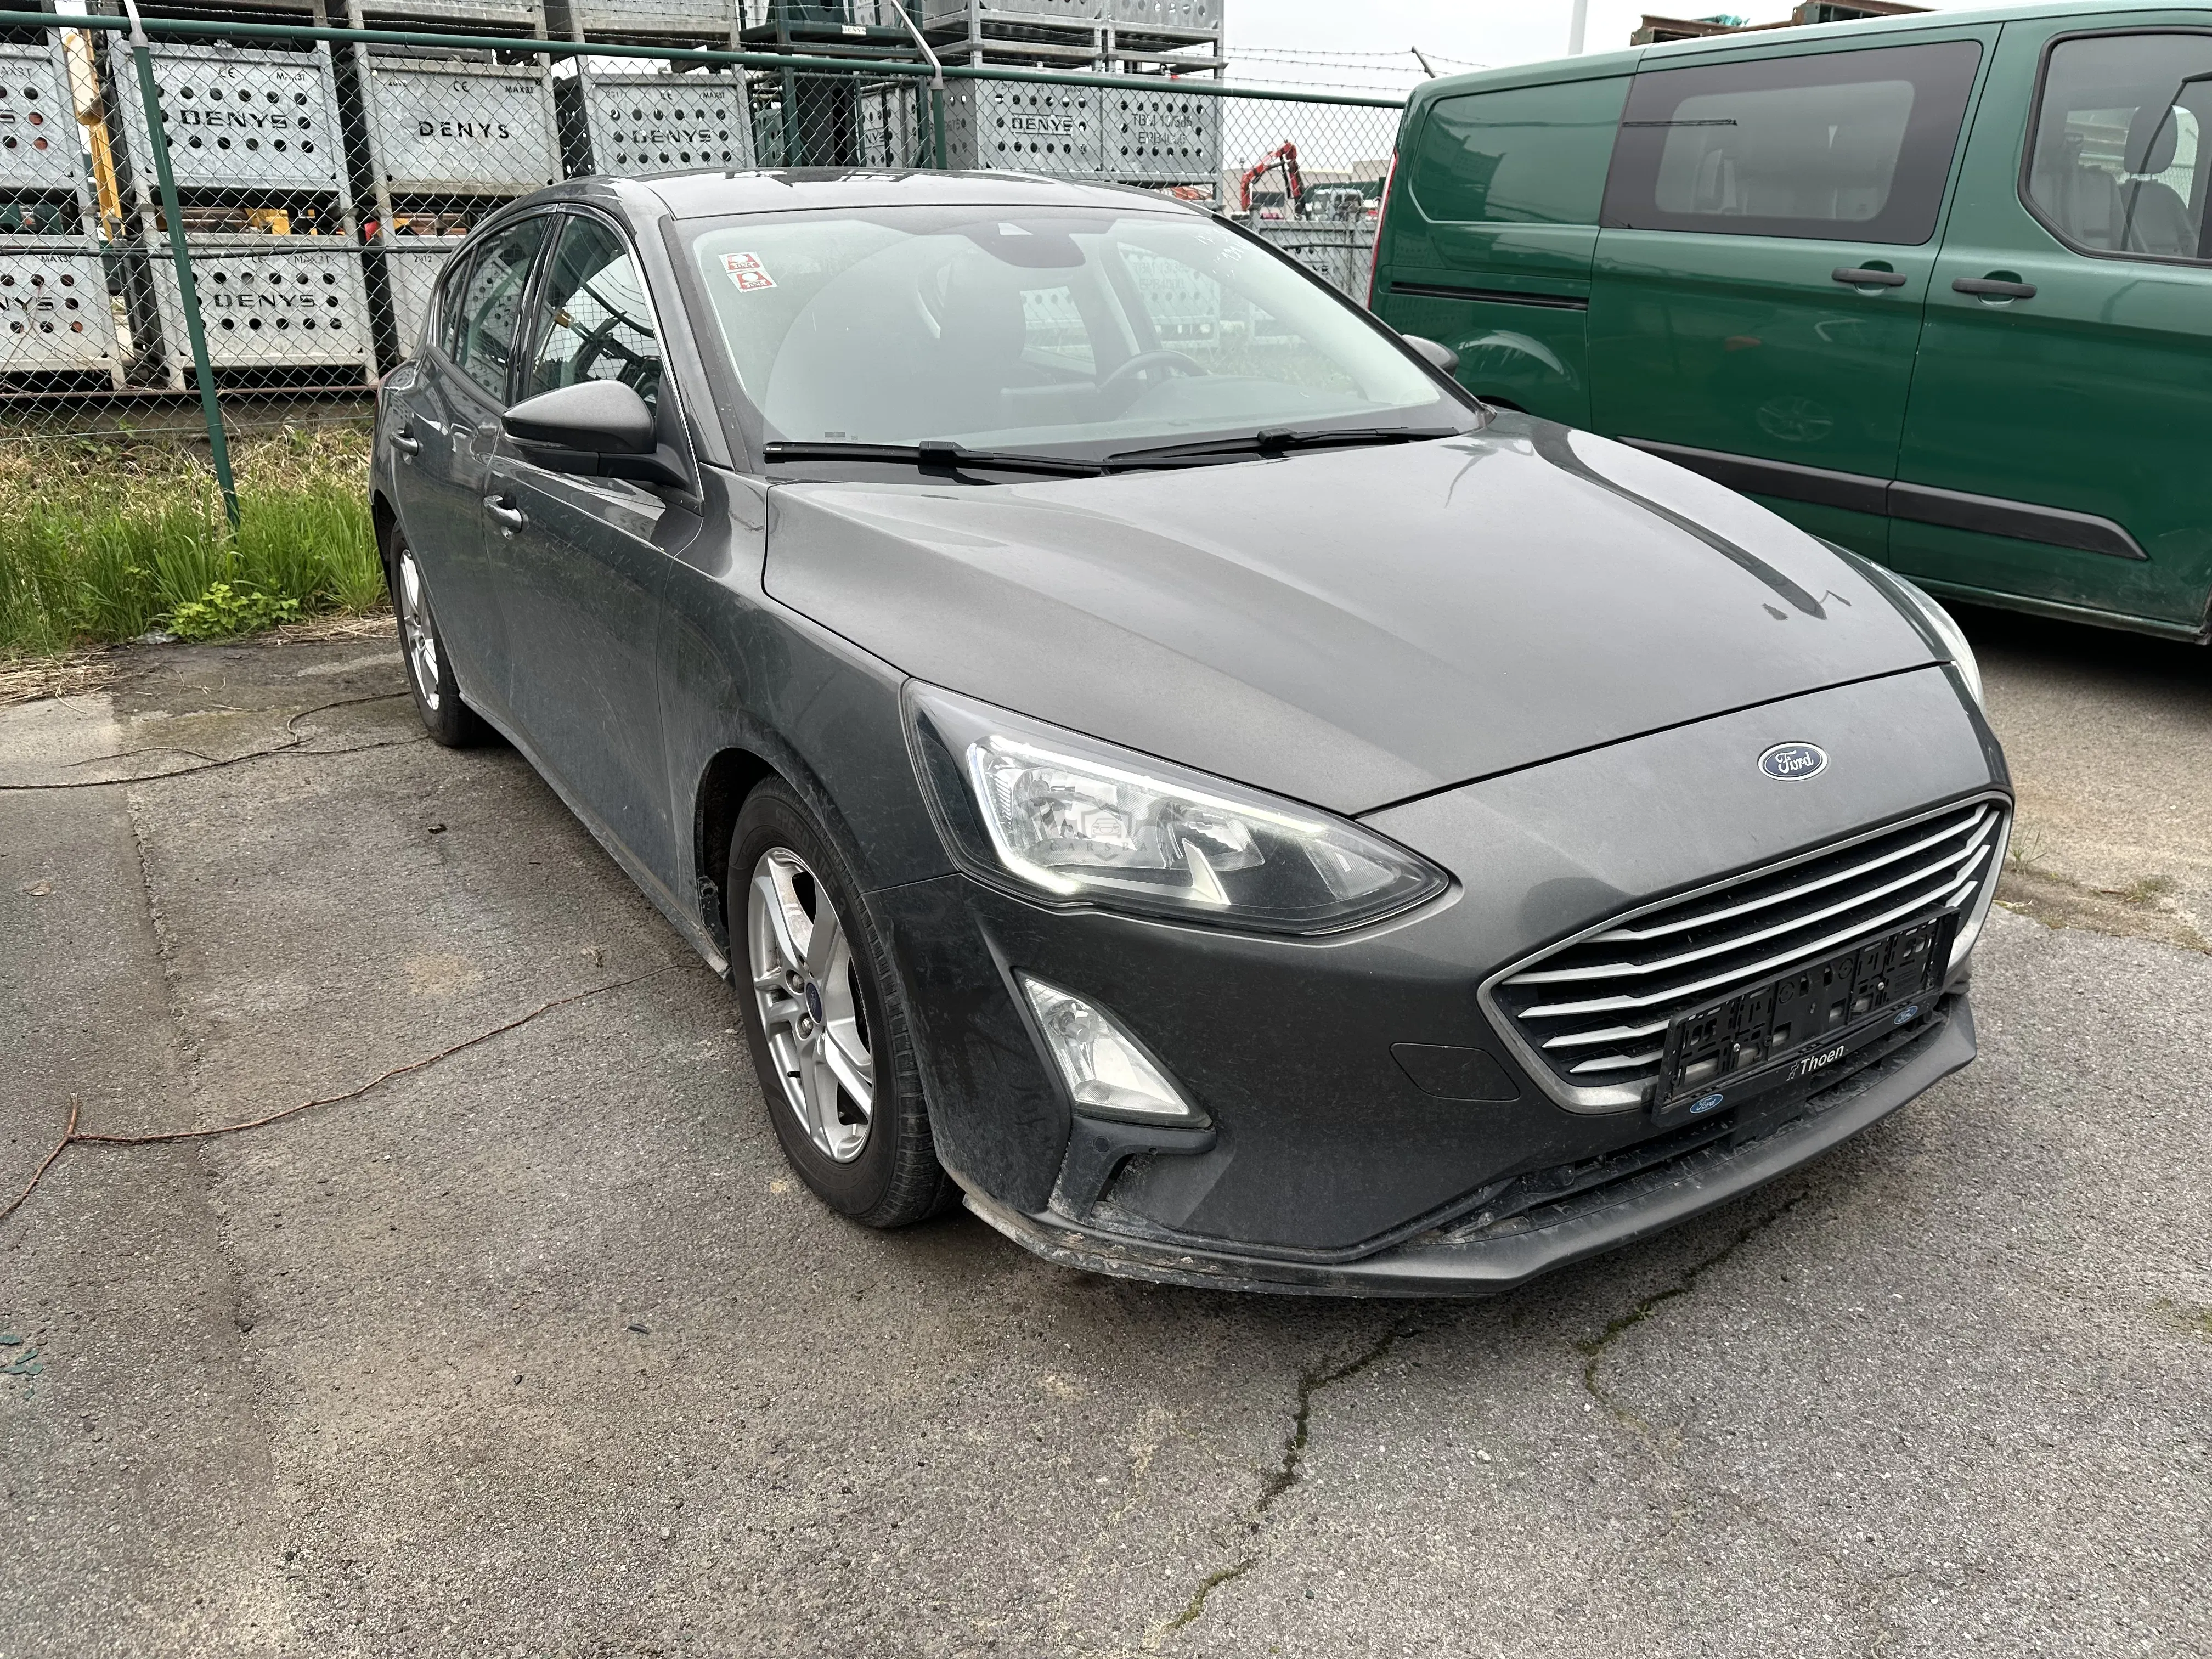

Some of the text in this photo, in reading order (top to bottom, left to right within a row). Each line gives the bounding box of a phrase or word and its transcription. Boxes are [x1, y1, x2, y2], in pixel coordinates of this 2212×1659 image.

[1, 66, 32, 77] AX3T
[151, 64, 168, 72] 017
[505, 85, 534, 94] MAX3T
[703, 91, 725, 99] MAX3T
[180, 110, 287, 129] DENYS
[1012, 117, 1073, 131] DENYS
[419, 120, 510, 139] DENYS
[632, 129, 712, 143] DENYS
[41, 255, 72, 263] MAX3T
[0, 297, 54, 311] NYS
[215, 294, 315, 308] DENYS
[1775, 750, 1814, 774] Ford
[1801, 1045, 1844, 1075] Thoen
[1696, 1097, 1717, 1111] Ford
